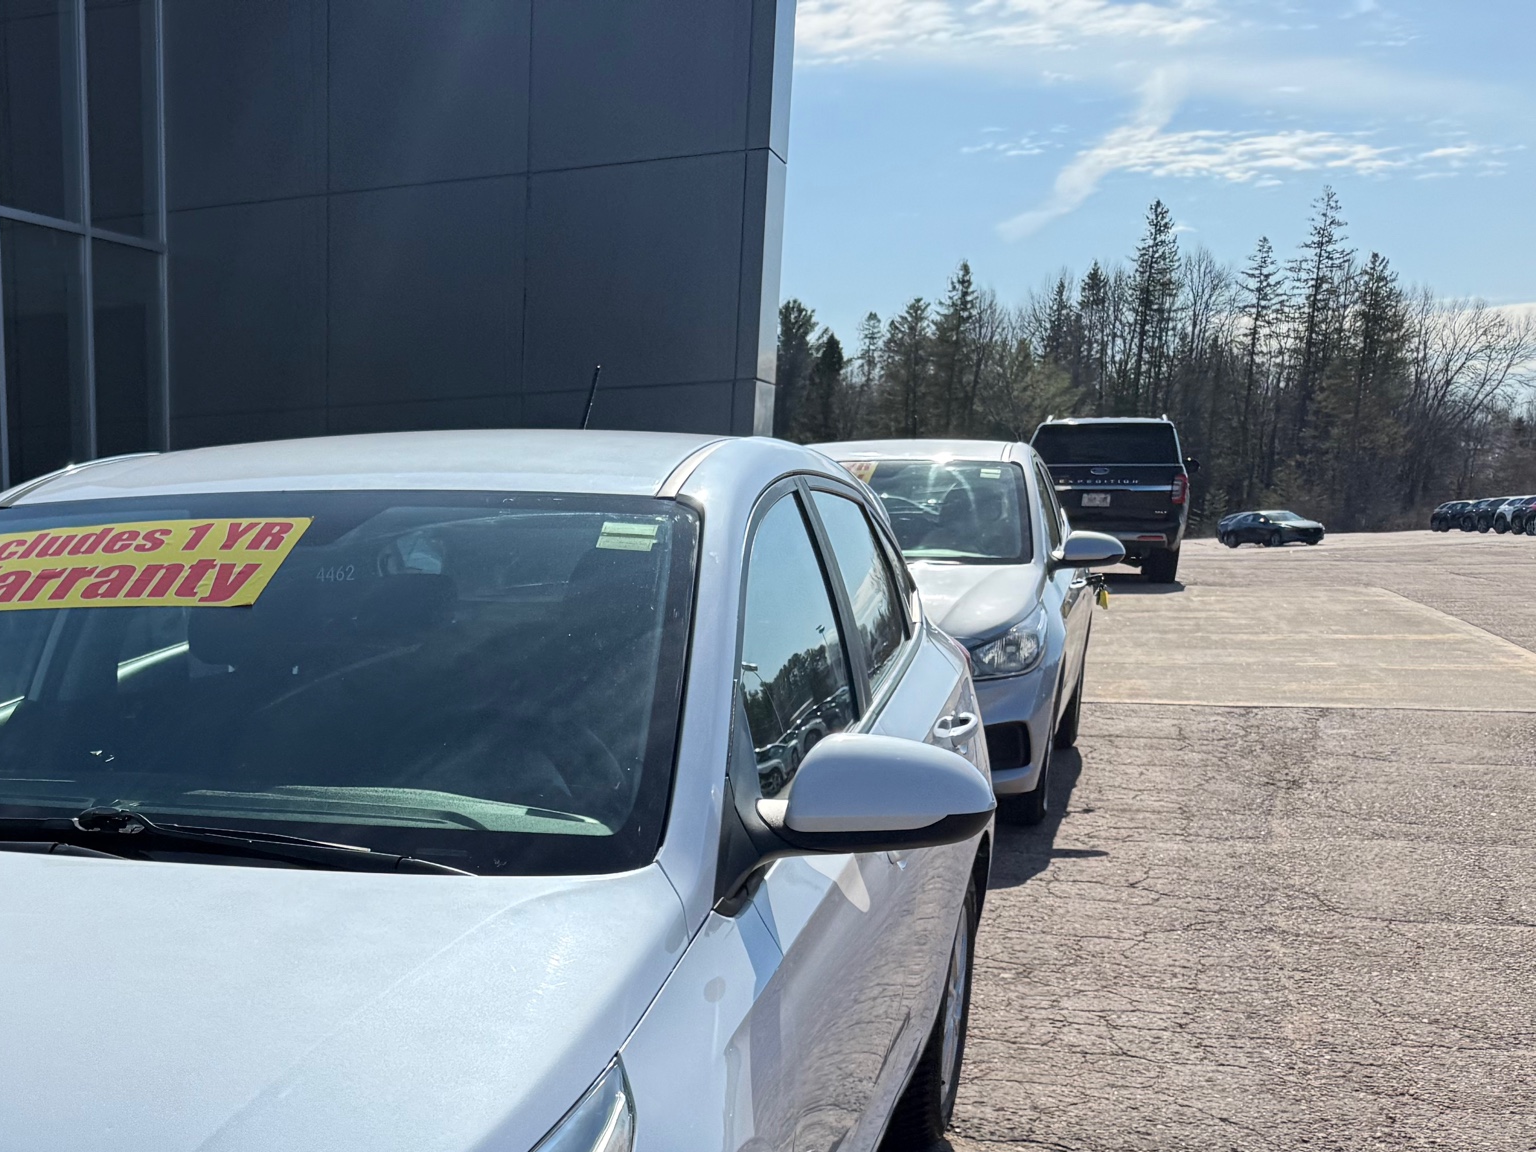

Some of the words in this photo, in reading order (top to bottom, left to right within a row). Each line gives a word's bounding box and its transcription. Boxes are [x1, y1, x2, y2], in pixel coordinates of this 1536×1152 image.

[181, 523, 215, 551] 1
[219, 522, 294, 551] YR
[316, 564, 355, 582] 4462
